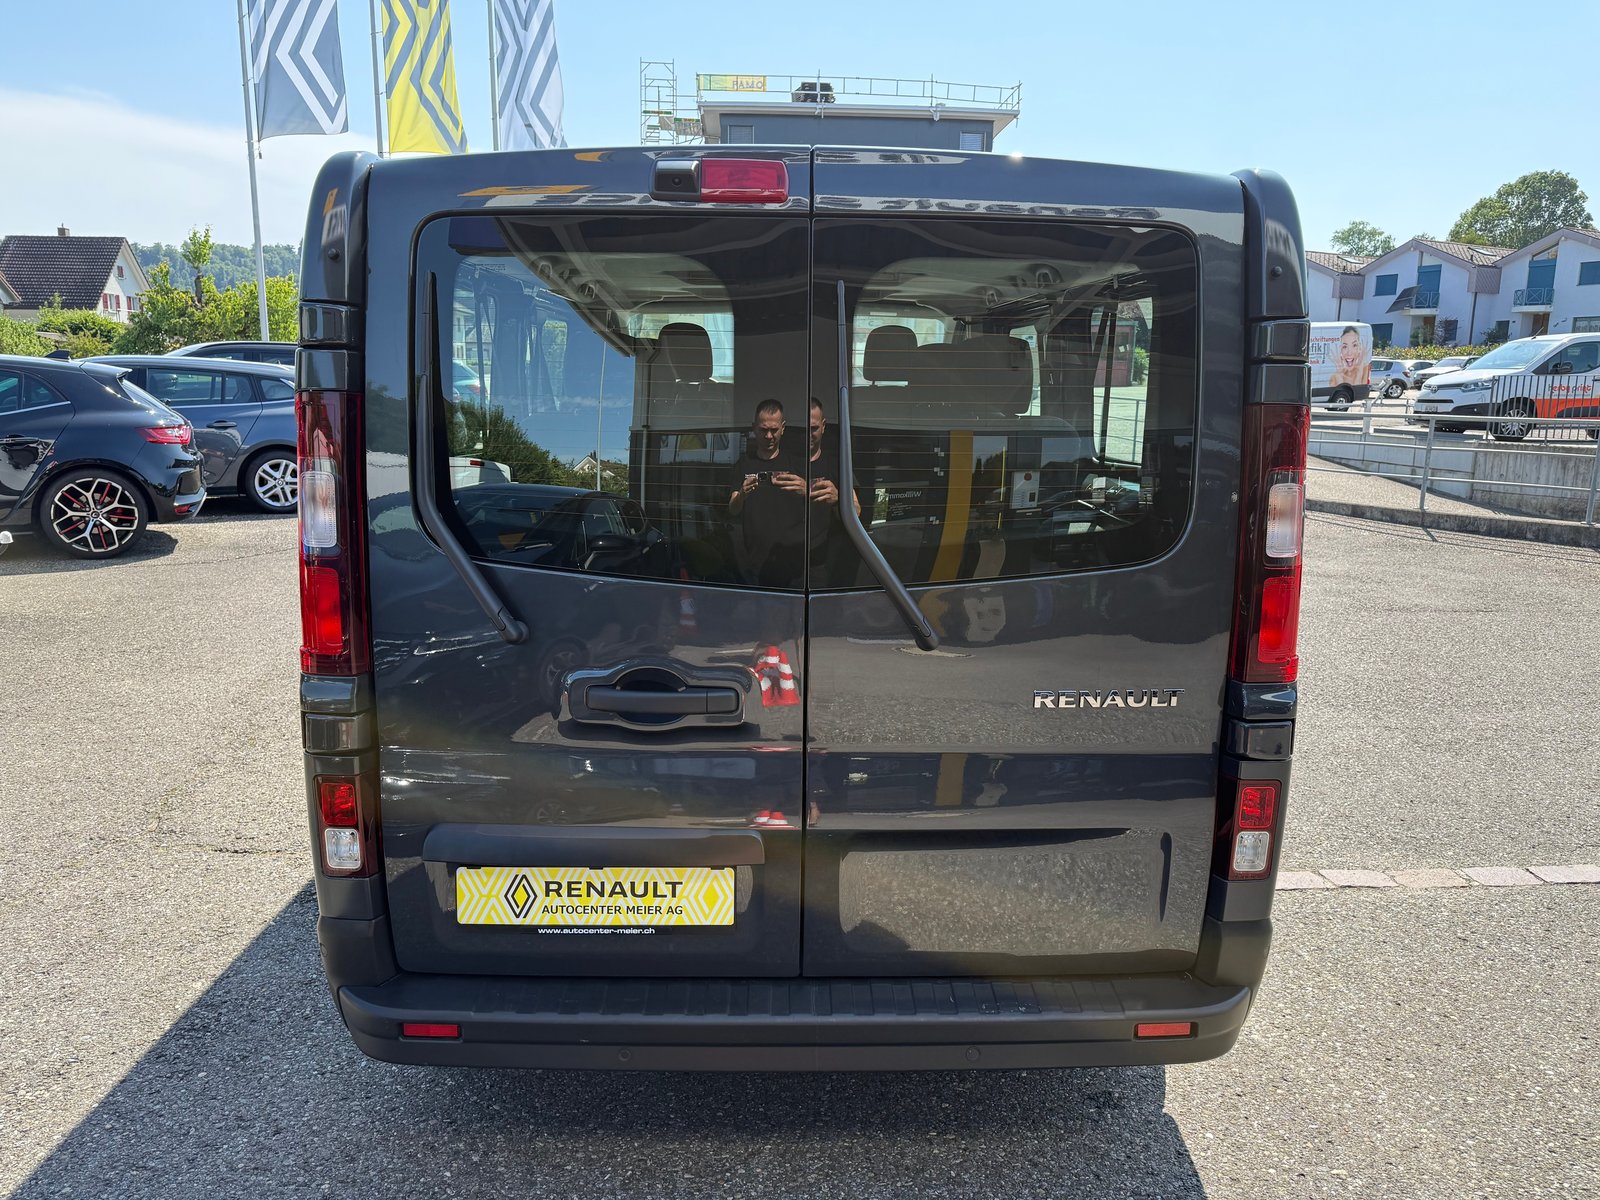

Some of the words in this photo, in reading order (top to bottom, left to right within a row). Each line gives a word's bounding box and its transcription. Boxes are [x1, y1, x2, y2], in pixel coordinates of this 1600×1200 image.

[1033, 688, 1185, 709] RENAULT
[544, 880, 683, 898] RENAULT
[541, 904, 623, 915] AUTOCENTER
[626, 904, 663, 915] MEIER
[666, 904, 683, 915] AG
[537, 927, 656, 935] www.autocenter-meier.ch
